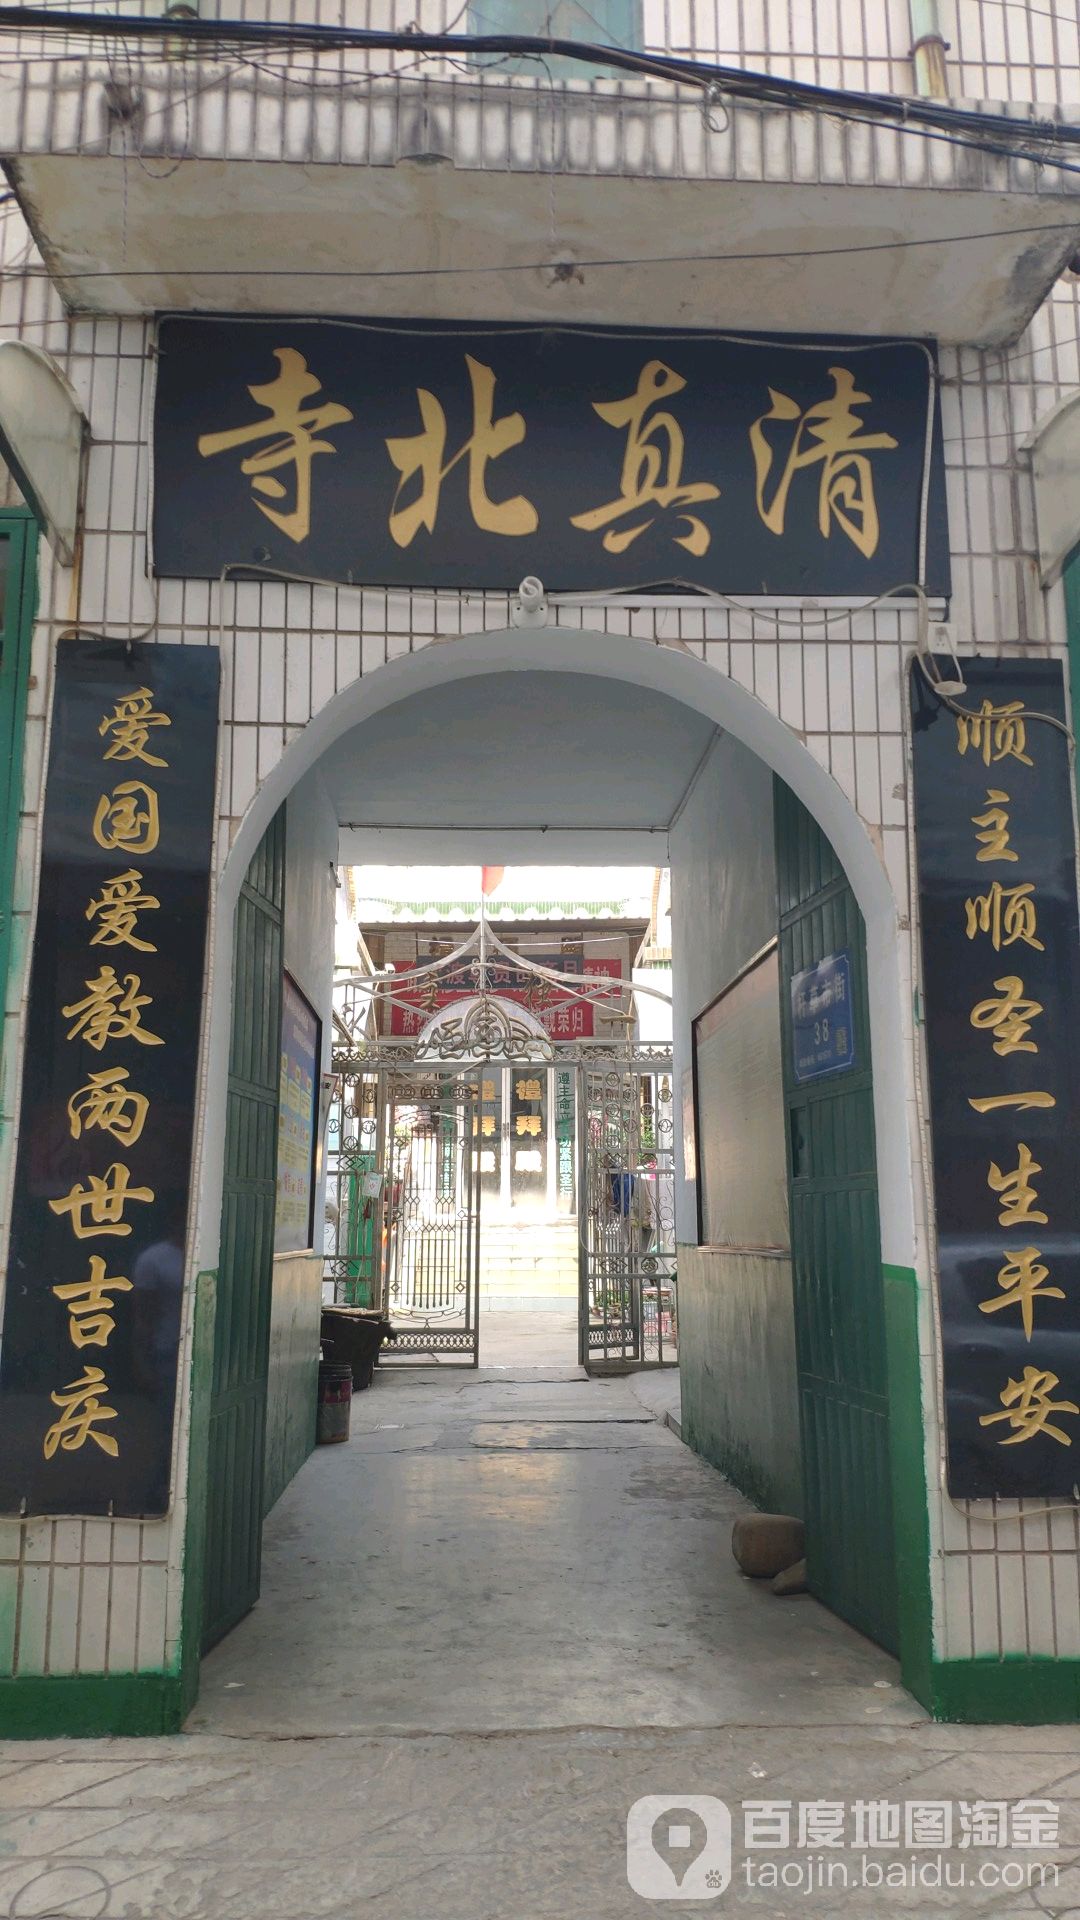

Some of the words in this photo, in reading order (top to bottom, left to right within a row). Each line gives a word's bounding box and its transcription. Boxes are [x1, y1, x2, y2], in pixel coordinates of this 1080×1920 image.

[197, 346, 898, 560] 清真北寺
[44, 686, 172, 1460] 爱国爱教两世吉庆
[815, 1019, 829, 1045] 38
[956, 699, 1079, 1447] 顺主顺圣一生平安
